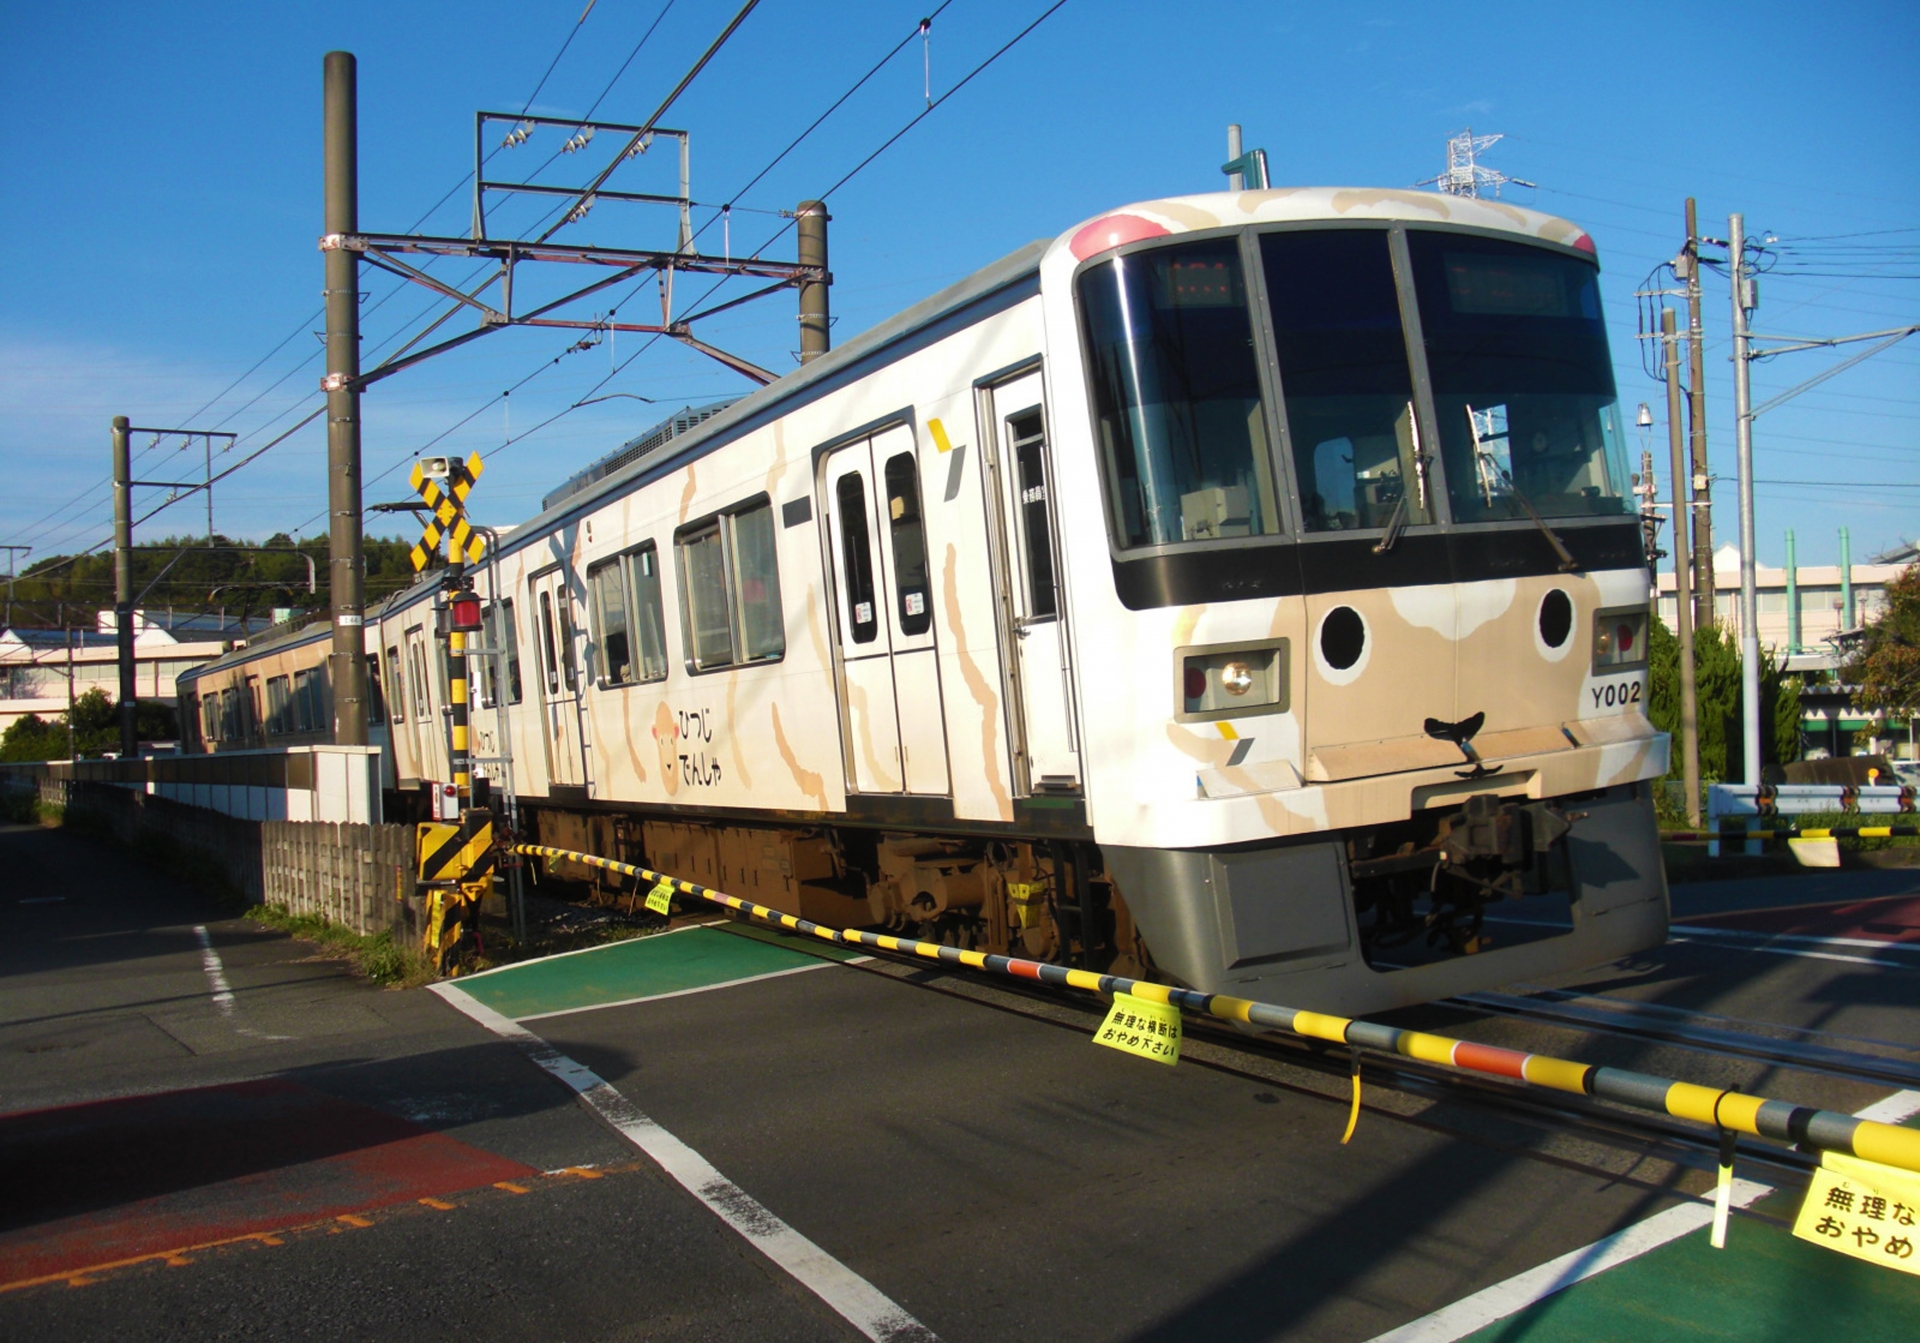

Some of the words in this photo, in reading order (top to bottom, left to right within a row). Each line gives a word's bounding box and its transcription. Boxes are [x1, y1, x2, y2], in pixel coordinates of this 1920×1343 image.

[1592, 681, 1641, 709] Y002
[679, 708, 713, 743] ひつじ
[679, 752, 722, 787] でんしゃ
[1102, 1028, 1175, 1056] おやめ下さい
[1111, 1011, 1178, 1039] 無理な横断は
[1824, 1187, 1916, 1226] 無理な
[1815, 1216, 1914, 1259] おやめ
